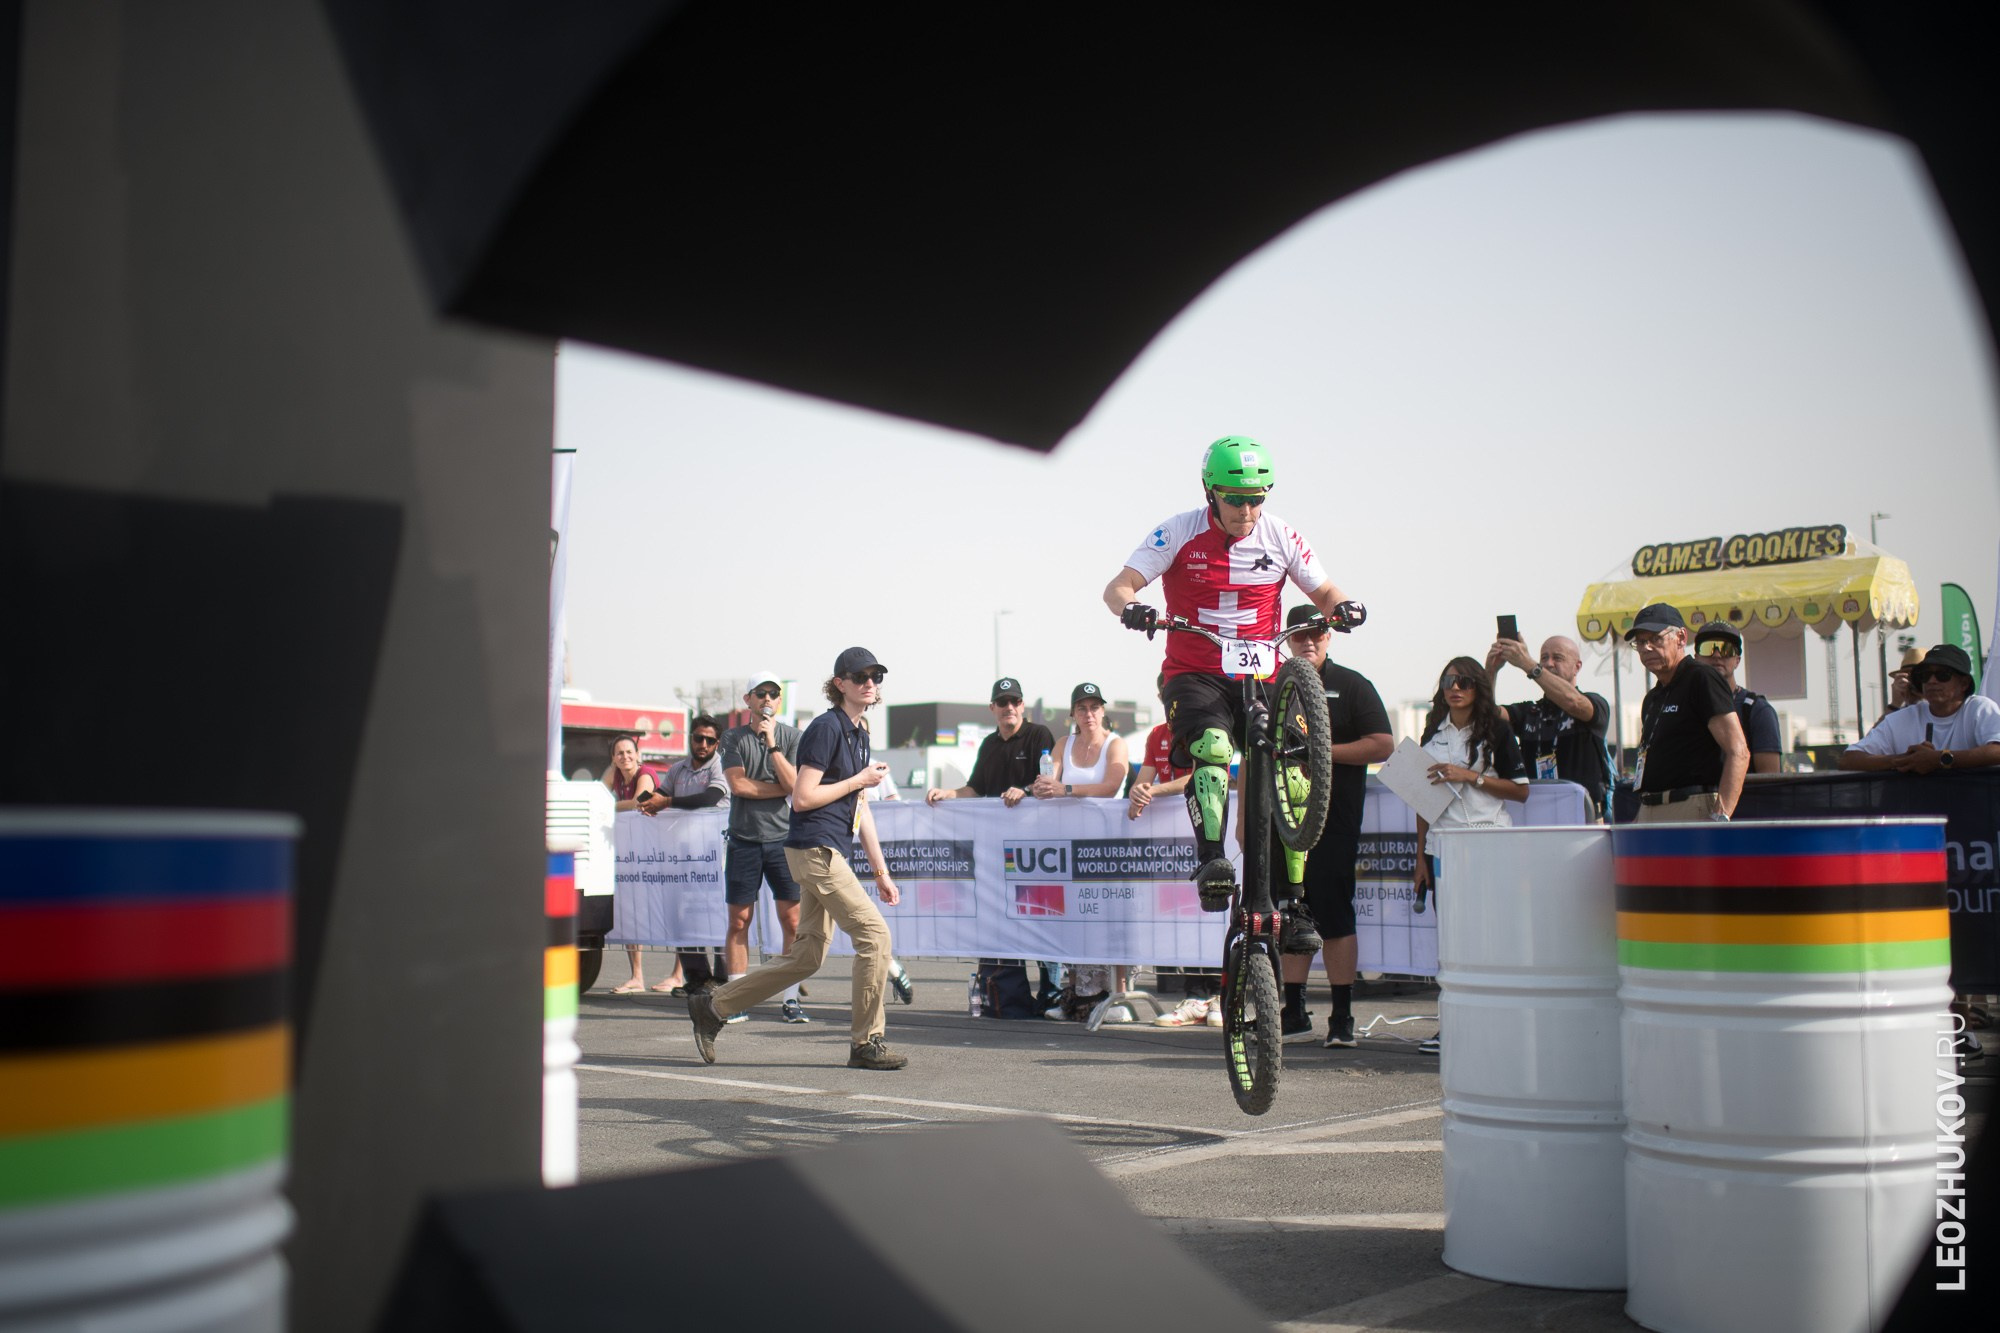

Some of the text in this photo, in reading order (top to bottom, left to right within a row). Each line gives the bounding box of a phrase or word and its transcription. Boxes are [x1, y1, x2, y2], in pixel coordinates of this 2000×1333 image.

[1634, 527, 1844, 576] CAMEL COOKIES
[1239, 652, 1262, 668] 3A
[882, 847, 908, 858] RBAN
[909, 847, 950, 858] CYCLING
[1077, 845, 1194, 859] 2024 URBAN CYCLING
[889, 860, 970, 873] CHAMPIONSHIPS
[1015, 847, 1067, 874] UCI
[1077, 862, 1118, 873] WORLD
[641, 871, 689, 886] Equipment
[690, 871, 719, 883] Rental
[1078, 887, 1135, 900] ABU DHABI
[1078, 902, 1100, 915] UAE
